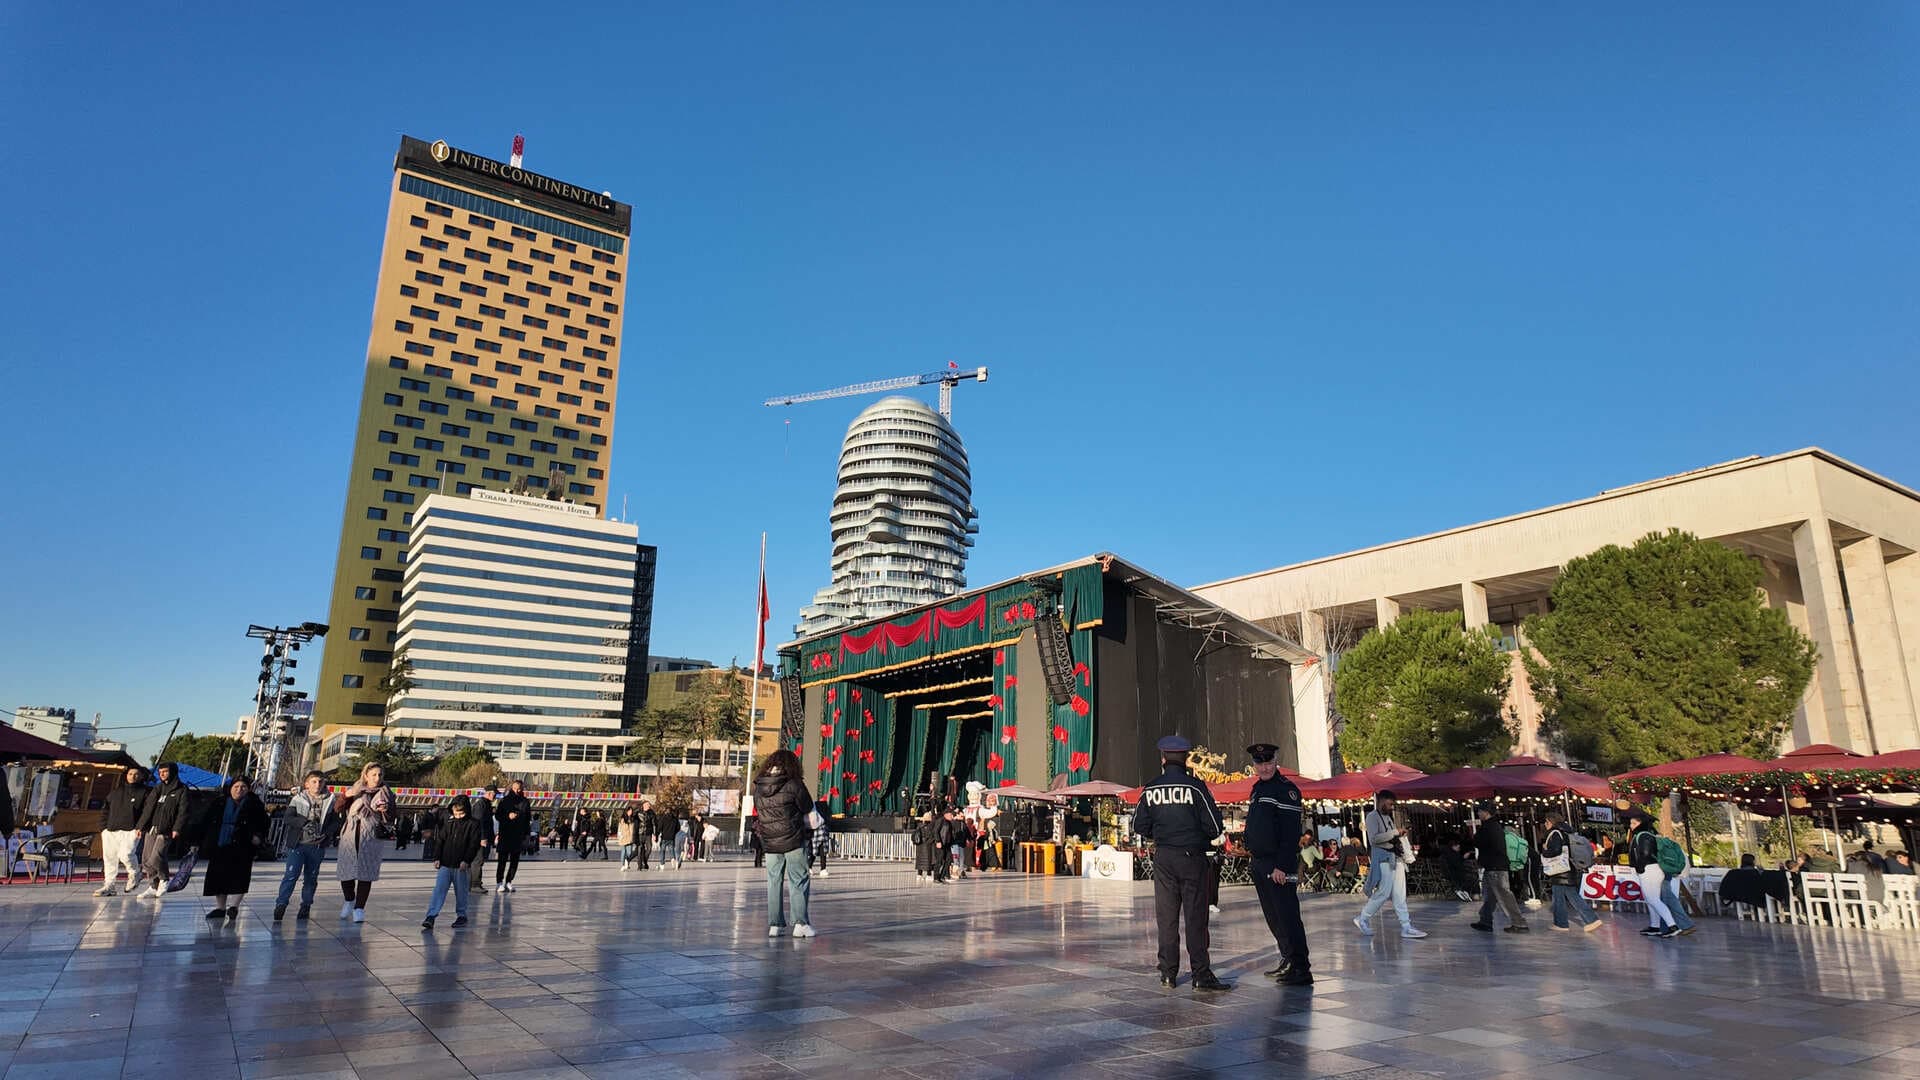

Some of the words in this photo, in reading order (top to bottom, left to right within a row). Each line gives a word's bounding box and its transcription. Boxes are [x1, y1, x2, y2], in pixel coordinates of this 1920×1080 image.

[510, 497, 564, 512] INTERNATIONAL
[1146, 787, 1194, 807] POLICIA
[1584, 872, 1644, 901] Ste
